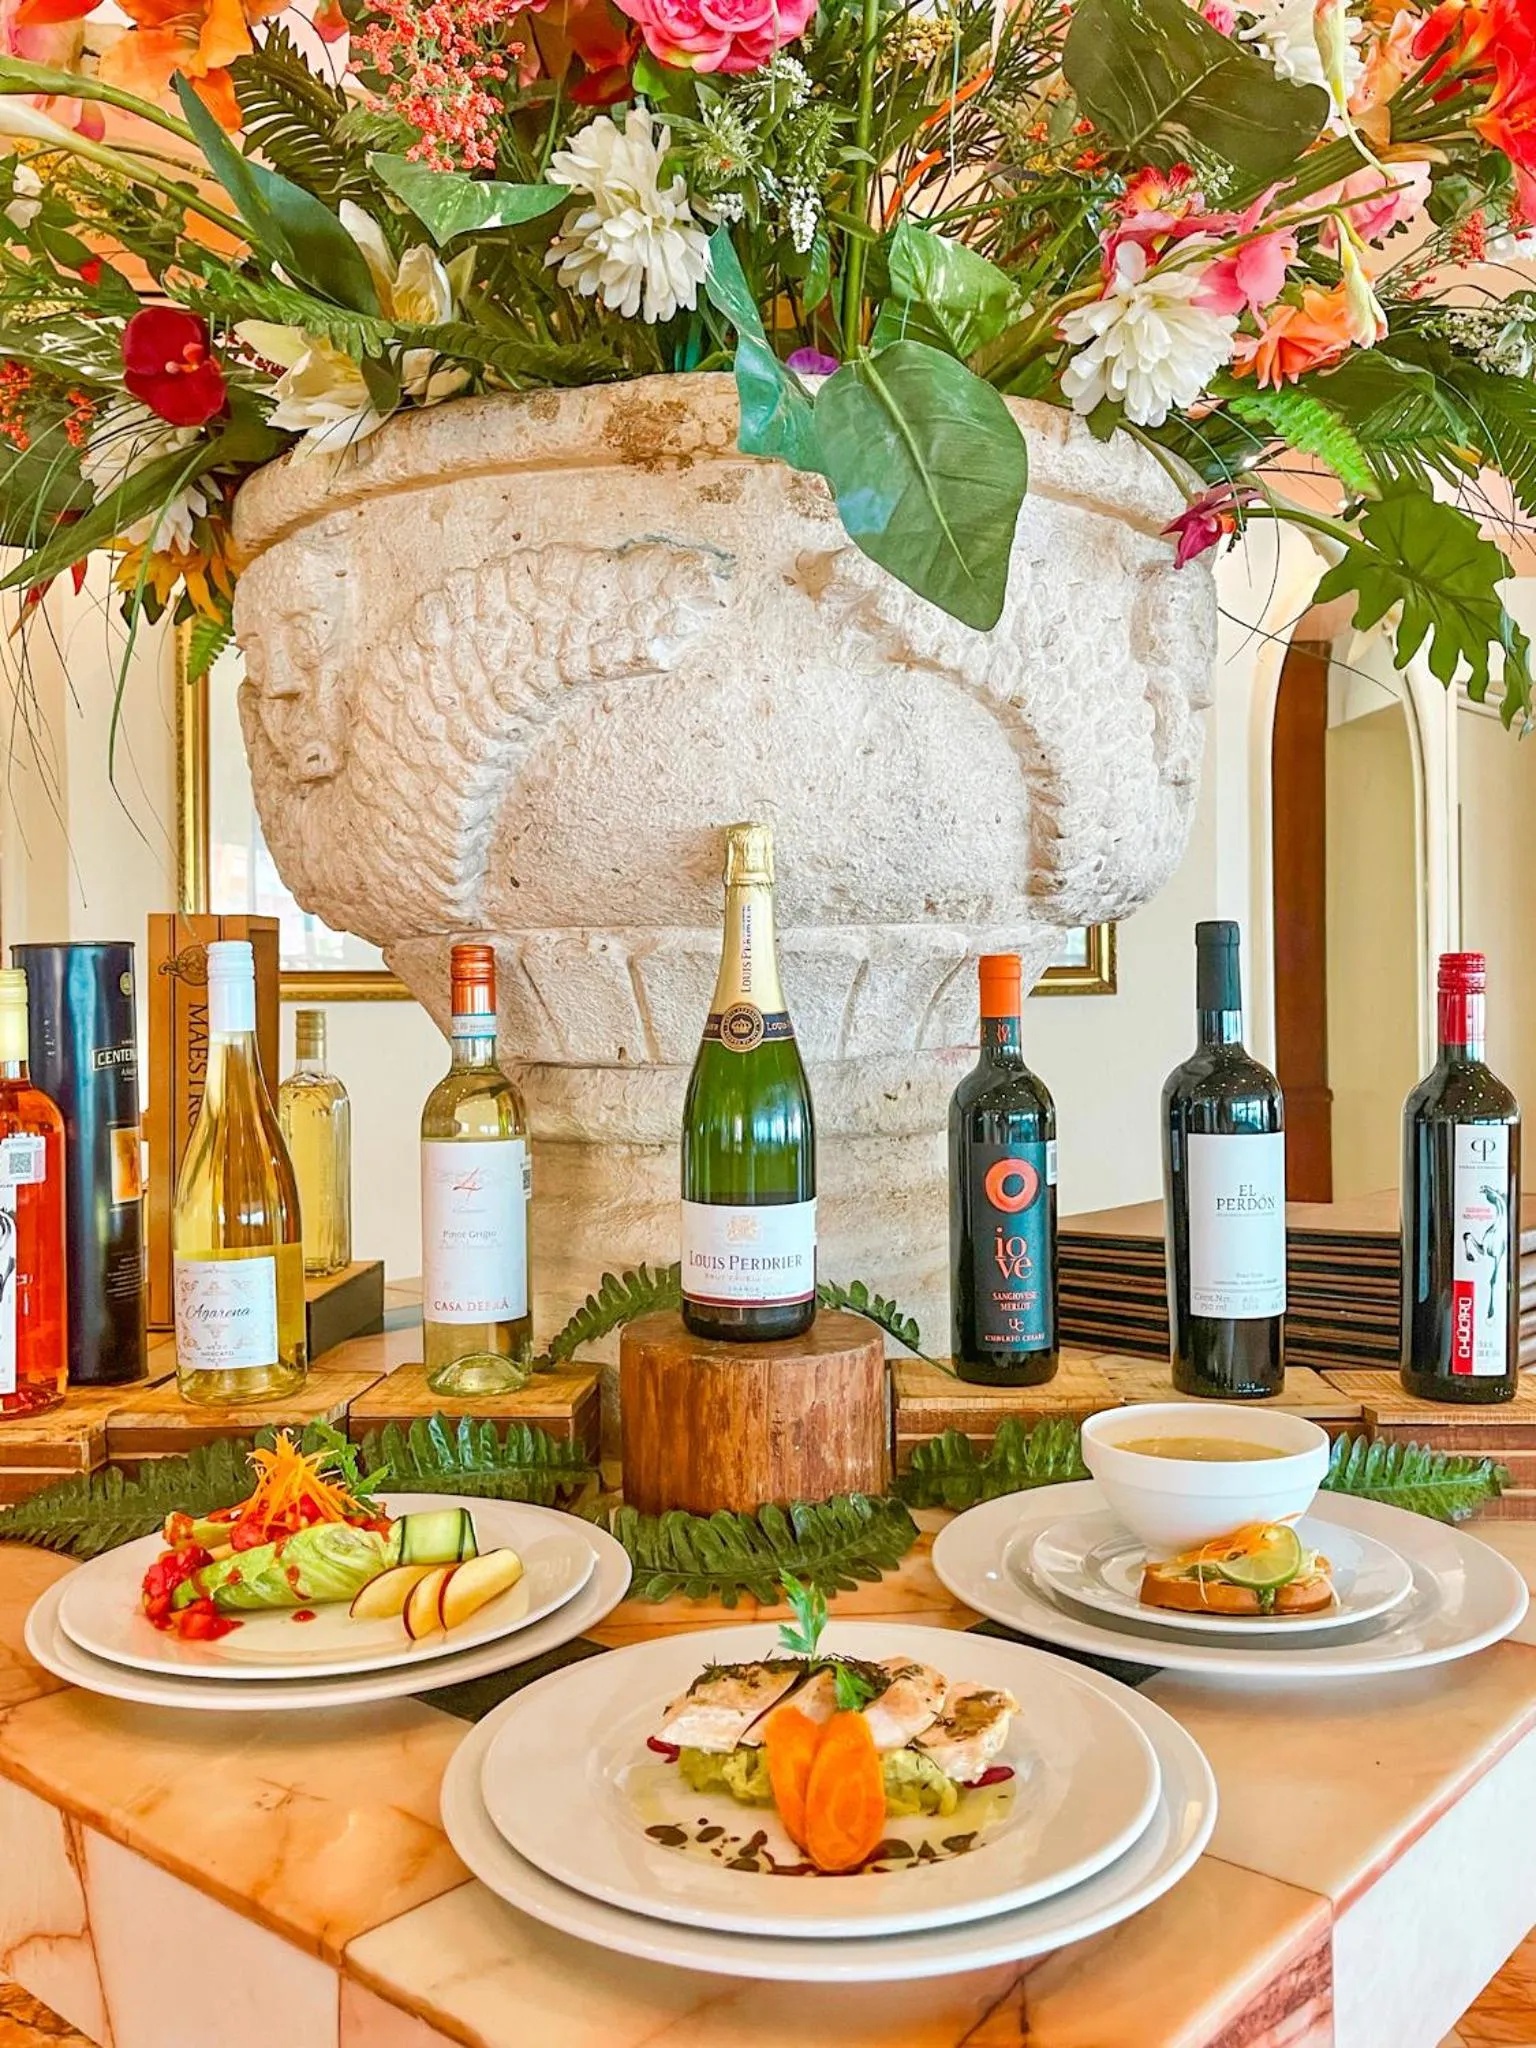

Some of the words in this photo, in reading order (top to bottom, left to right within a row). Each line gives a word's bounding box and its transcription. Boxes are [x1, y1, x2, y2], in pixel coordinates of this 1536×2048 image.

[740, 961, 752, 993] LOUIS
[1239, 1184, 1256, 1197] EL
[1216, 1195, 1275, 1211] PERDÓN
[689, 1250, 726, 1270] LOUIS
[729, 1255, 803, 1271] PERDRIER
[433, 1300, 463, 1312] CASA
